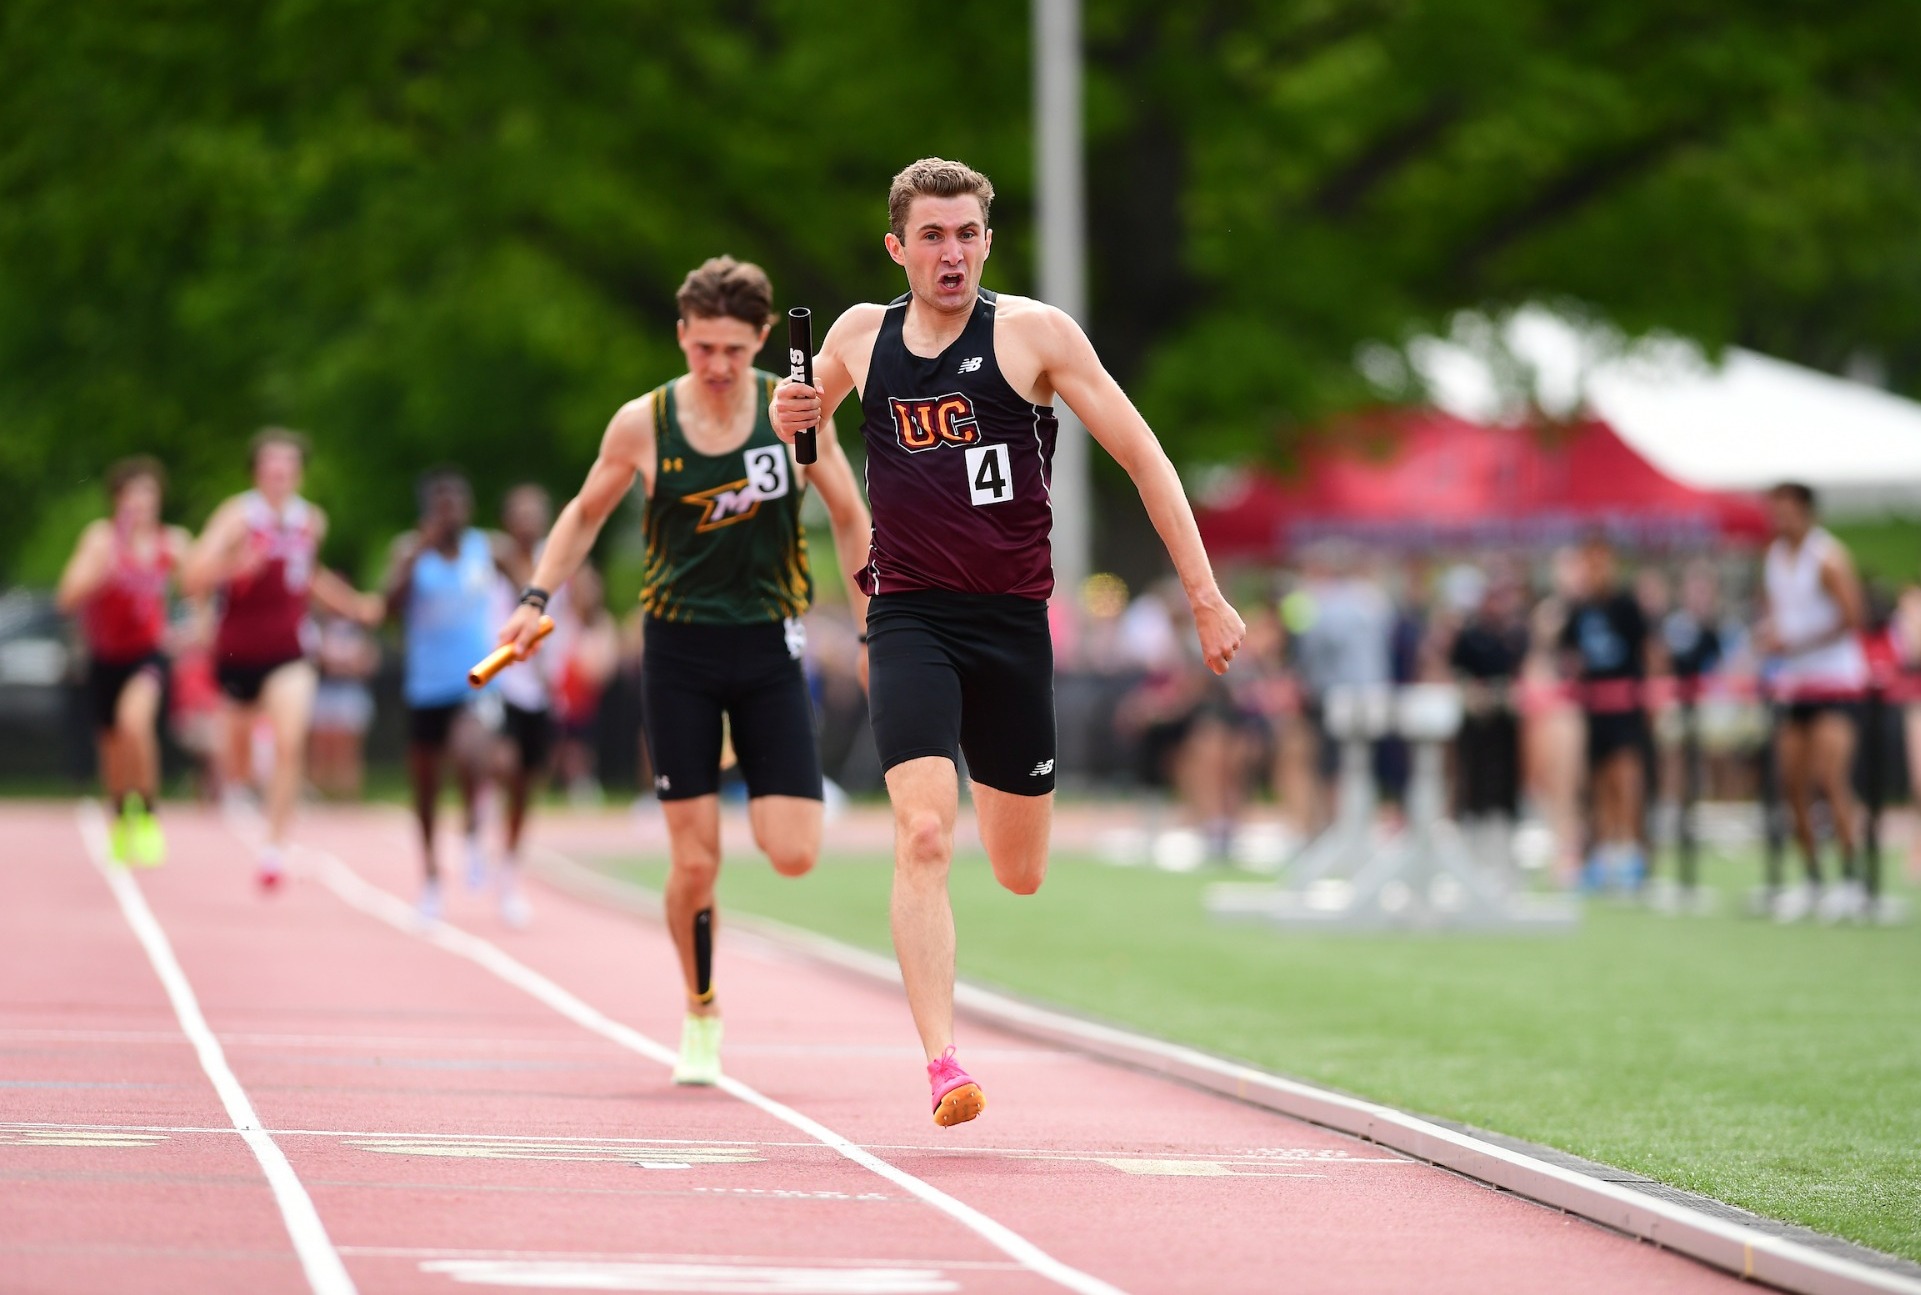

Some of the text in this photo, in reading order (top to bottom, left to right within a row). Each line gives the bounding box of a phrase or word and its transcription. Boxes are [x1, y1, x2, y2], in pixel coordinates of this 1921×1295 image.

[890, 394, 979, 451] UC
[755, 454, 779, 492] 3
[975, 449, 1006, 498] 4
